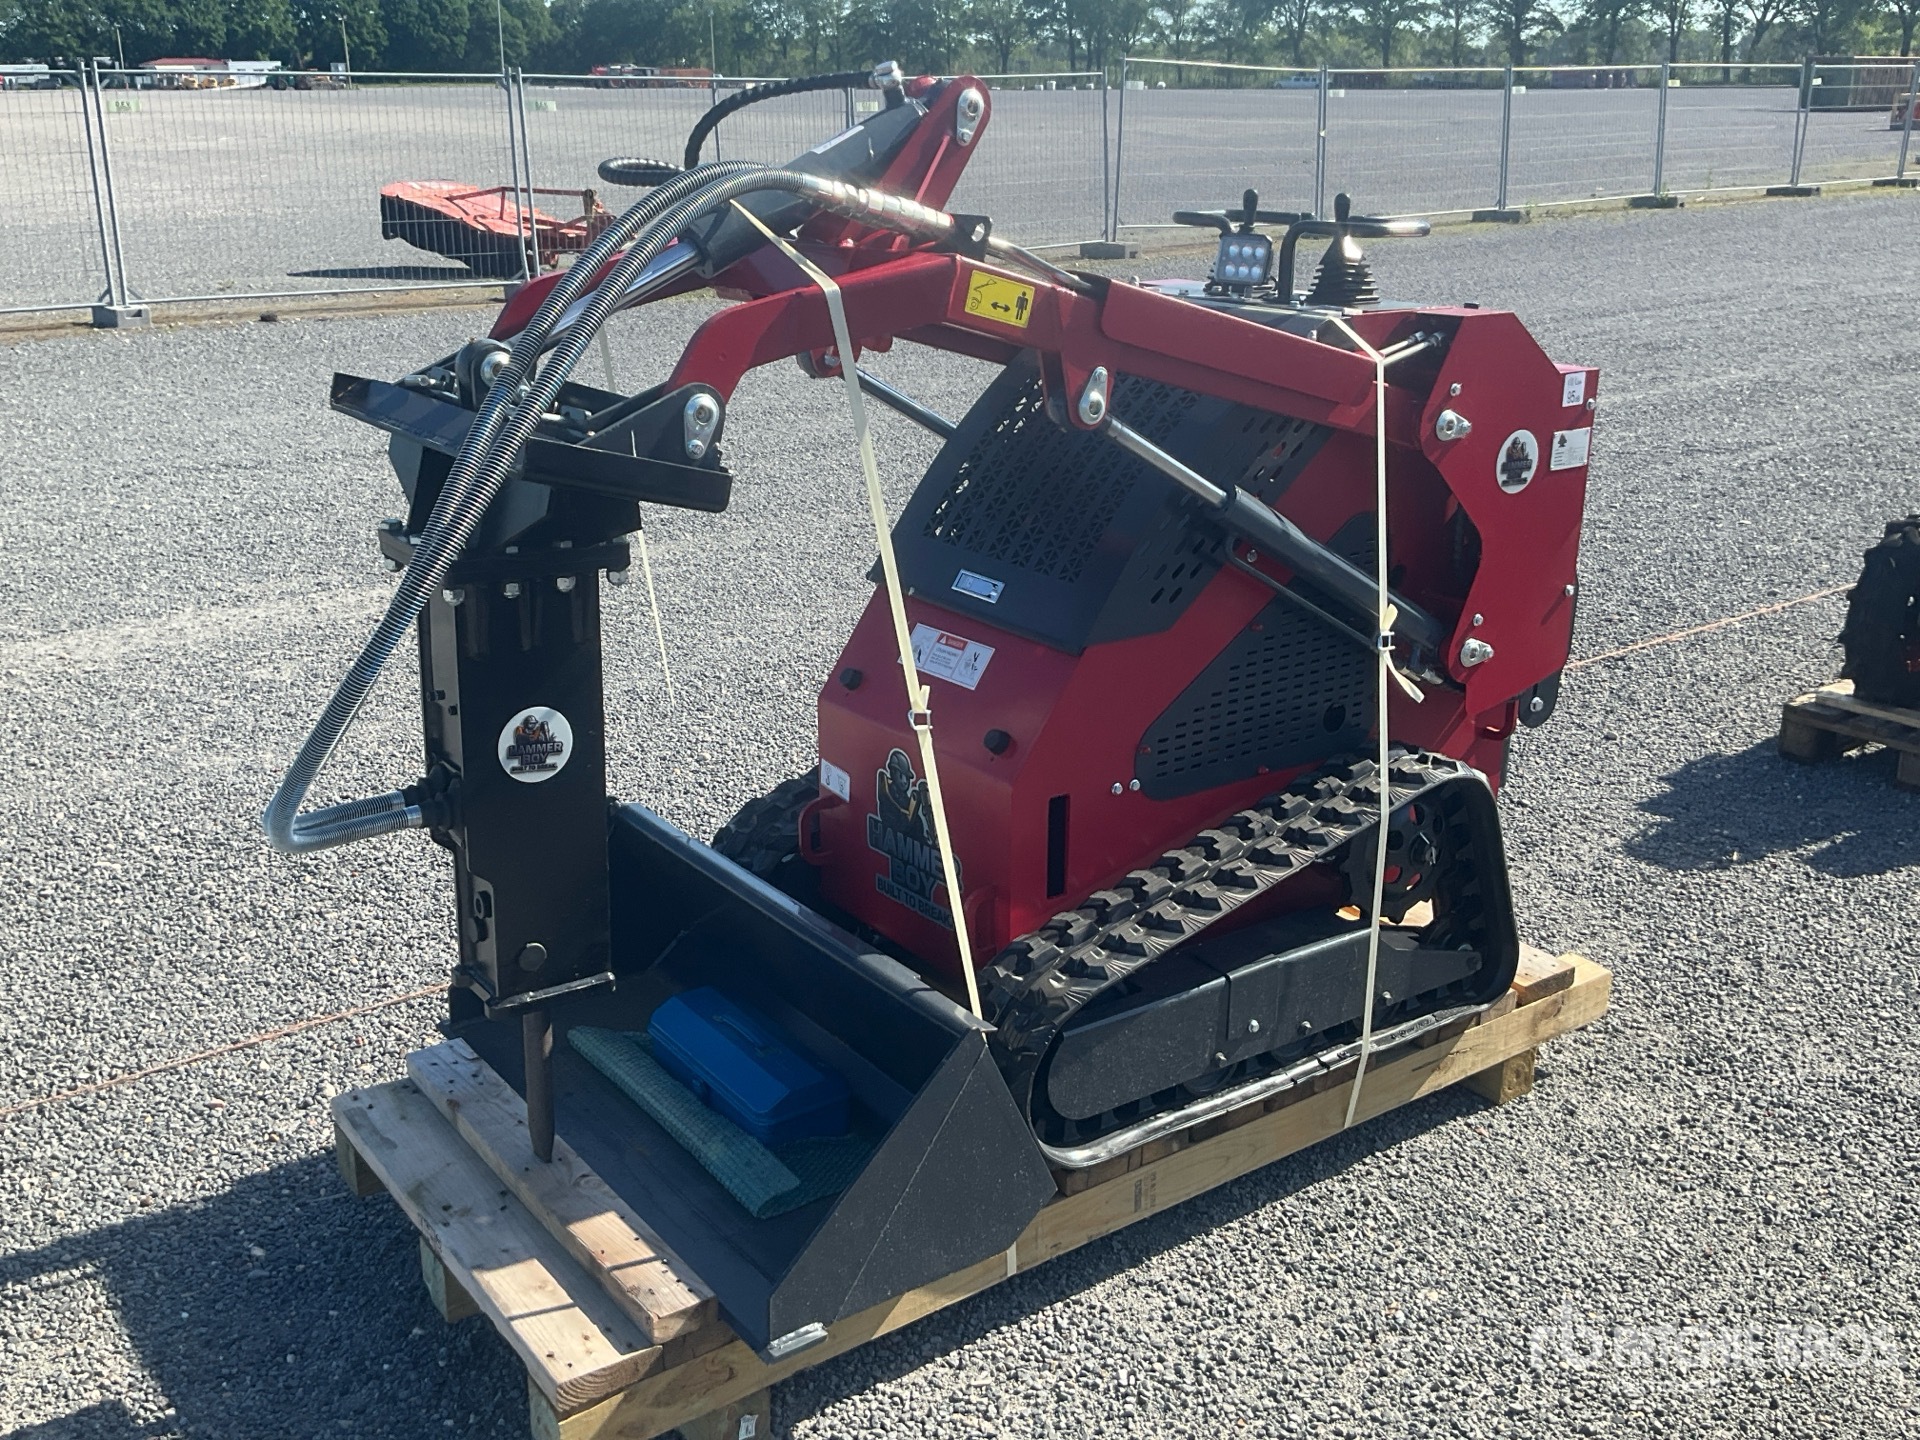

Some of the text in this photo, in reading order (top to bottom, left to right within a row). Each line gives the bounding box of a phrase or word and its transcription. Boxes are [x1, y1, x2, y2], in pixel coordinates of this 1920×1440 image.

[508, 742, 562, 756] HAMMER
[522, 753, 548, 764] BOY
[891, 858, 935, 898] BOY
[877, 876, 902, 900] BUILT
[903, 889, 916, 907] TO
